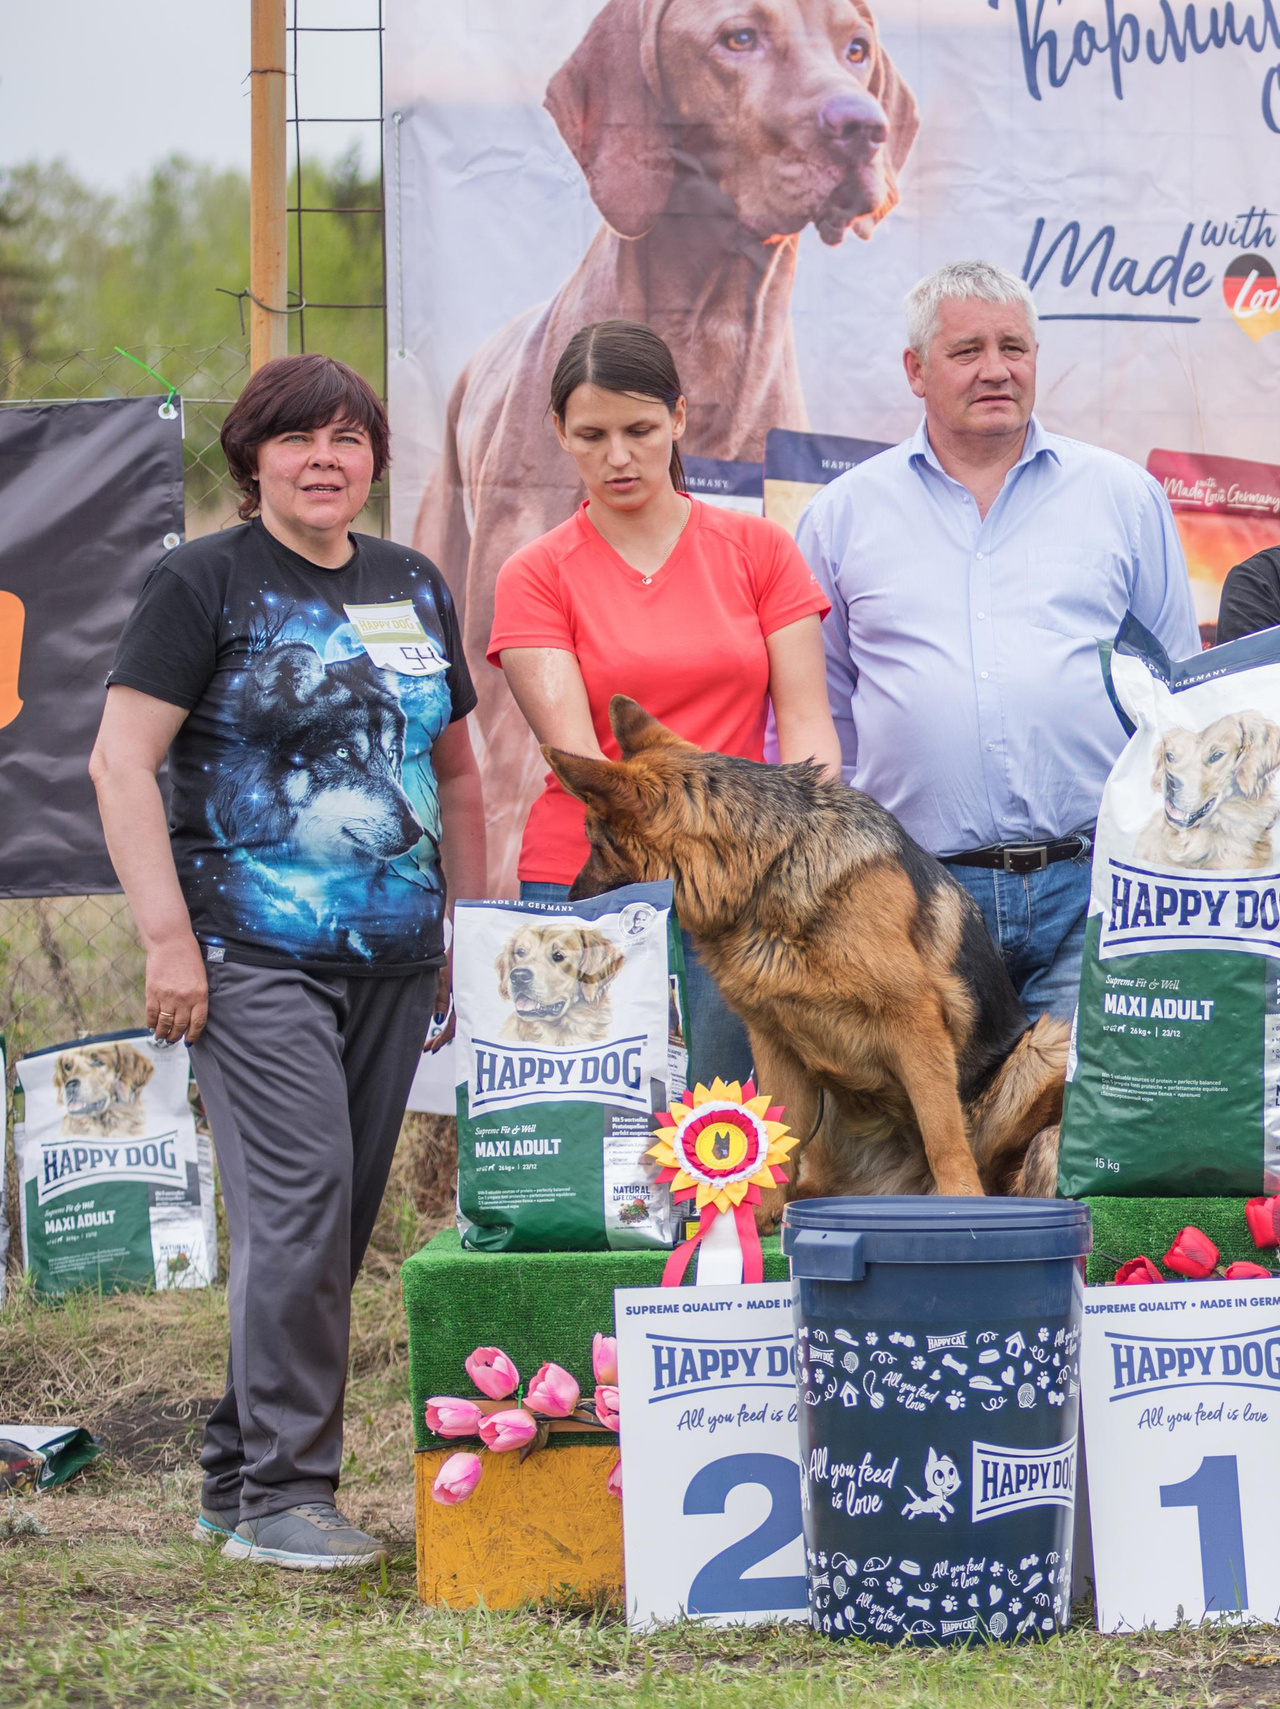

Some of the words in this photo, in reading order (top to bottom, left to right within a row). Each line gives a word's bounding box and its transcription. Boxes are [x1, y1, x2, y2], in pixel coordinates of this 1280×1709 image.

[1020, 216, 1213, 306] Made
[1200, 205, 1277, 249] with
[1164, 477, 1203, 498] Made
[1204, 488, 1225, 507] Love
[1227, 484, 1280, 514] Germany
[528, 901, 574, 912] GERMANY
[1108, 874, 1230, 932] HAPPY
[1105, 975, 1134, 989] Supreme
[1135, 978, 1147, 988] Fit
[1161, 979, 1180, 990] Well
[1104, 993, 1147, 1019] MAXI
[1150, 998, 1215, 1021] ADULT
[475, 1050, 577, 1096] HAPPY
[581, 1047, 642, 1090] DOG
[475, 1127, 500, 1137] Supreme
[500, 1125, 510, 1134] Fit
[521, 1124, 536, 1133] Well
[475, 1141, 510, 1158] MAXI
[513, 1138, 562, 1156] ADULT
[42, 1148, 119, 1186] HAPPY
[126, 1140, 177, 1171] DOG
[1094, 1158, 1105, 1169] 15
[1106, 1158, 1120, 1172] kg
[613, 1186, 650, 1194] NATURAL
[44, 1216, 75, 1235] MAXI
[77, 1210, 116, 1229] ADULT
[625, 1304, 680, 1316] SUPREME
[682, 1302, 733, 1315] QUALITY
[746, 1299, 781, 1310] MADE
[1084, 1304, 1136, 1314] SUPREME
[1138, 1301, 1187, 1312] QUALITY
[1200, 1299, 1232, 1309] MADE
[1235, 1298, 1247, 1307] IN
[928, 1339, 950, 1350] HAPPY
[951, 1335, 967, 1345] CAT
[652, 1344, 761, 1390] HAPPY
[1111, 1343, 1216, 1389] HAPPY
[882, 1371, 903, 1388] All
[899, 1382, 918, 1394] you
[916, 1383, 940, 1403] feed
[896, 1394, 905, 1403] is
[905, 1394, 926, 1411] love
[1138, 1406, 1164, 1429] All
[1167, 1410, 1192, 1431] you
[1195, 1402, 1223, 1425] feed
[1227, 1407, 1238, 1422] is
[1243, 1402, 1269, 1423] love
[677, 1410, 705, 1431] All
[707, 1409, 733, 1433] you
[737, 1402, 767, 1424] feed
[770, 1405, 784, 1422] is
[809, 1447, 828, 1482] All
[831, 1464, 856, 1486] you
[858, 1452, 899, 1489] feed
[980, 1460, 1050, 1503] HAPPY
[1052, 1453, 1075, 1492] DOG
[832, 1491, 843, 1509] is
[847, 1481, 883, 1517] love
[683, 1452, 806, 1614] 2
[1159, 1455, 1249, 1611] 1
[931, 1560, 949, 1579] All
[950, 1565, 966, 1578] you
[966, 1557, 986, 1575] feed
[960, 1573, 980, 1589] love
[942, 1621, 962, 1633] HAPPY
[963, 1618, 976, 1629] CAT
